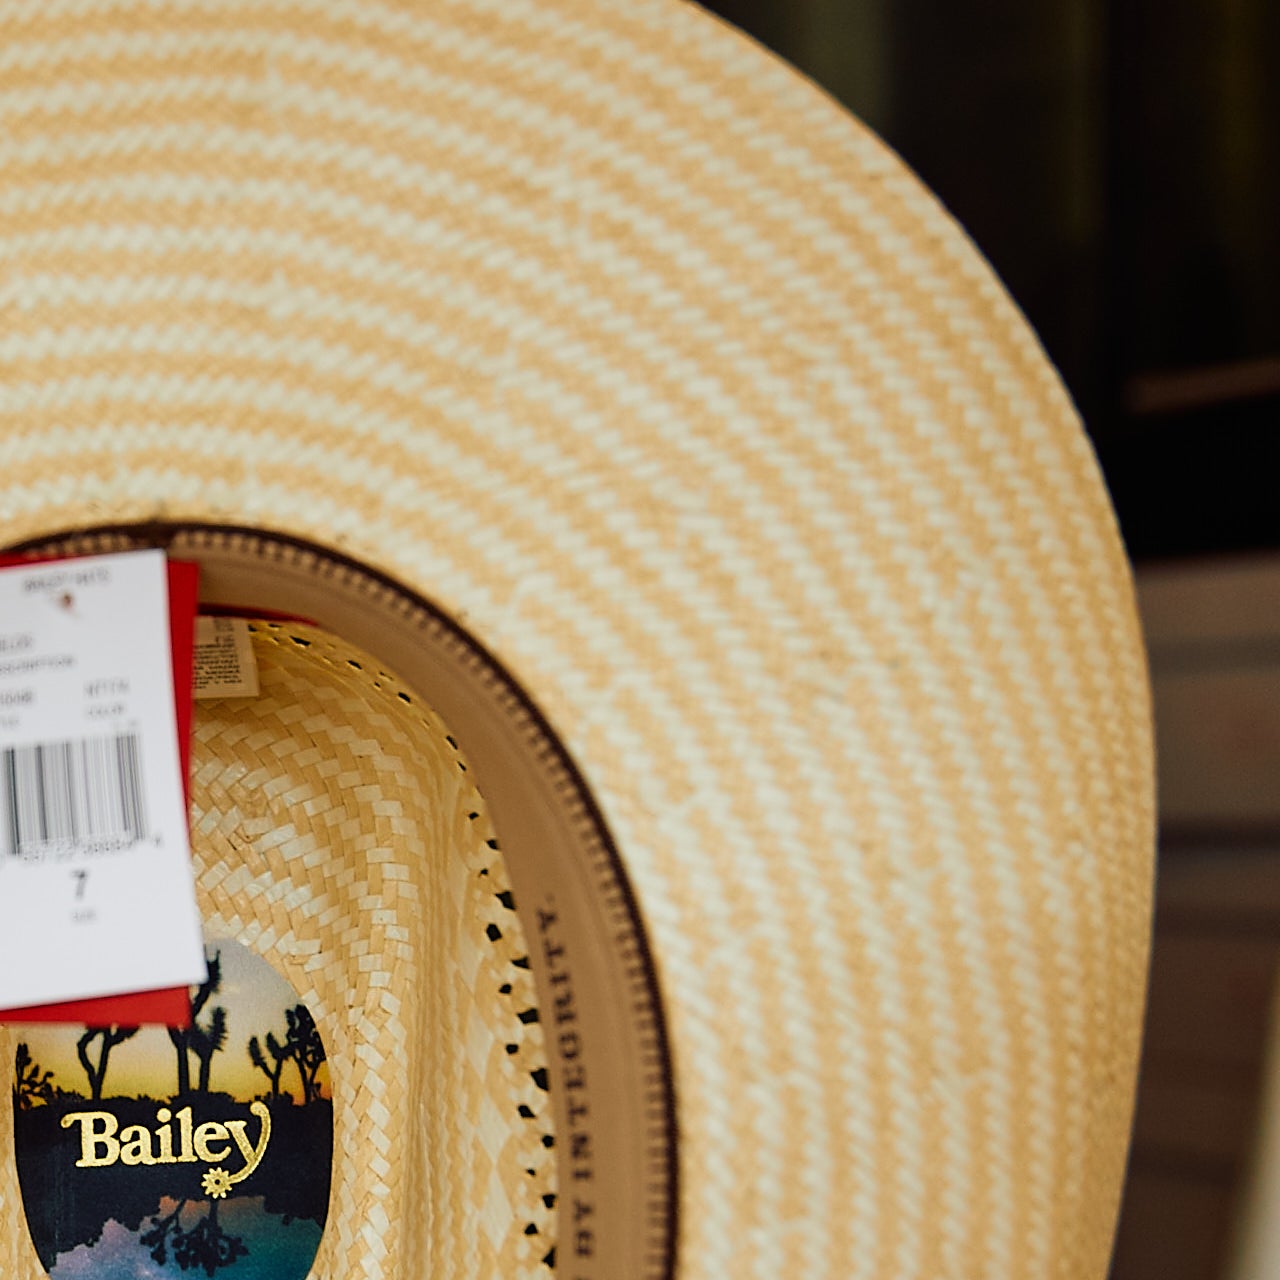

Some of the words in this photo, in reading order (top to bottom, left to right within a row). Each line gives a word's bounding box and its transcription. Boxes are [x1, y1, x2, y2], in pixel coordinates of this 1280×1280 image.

[71, 868, 88, 899] 7
[60, 1100, 272, 1199] Bailey
[570, 1197, 594, 1259] BY
